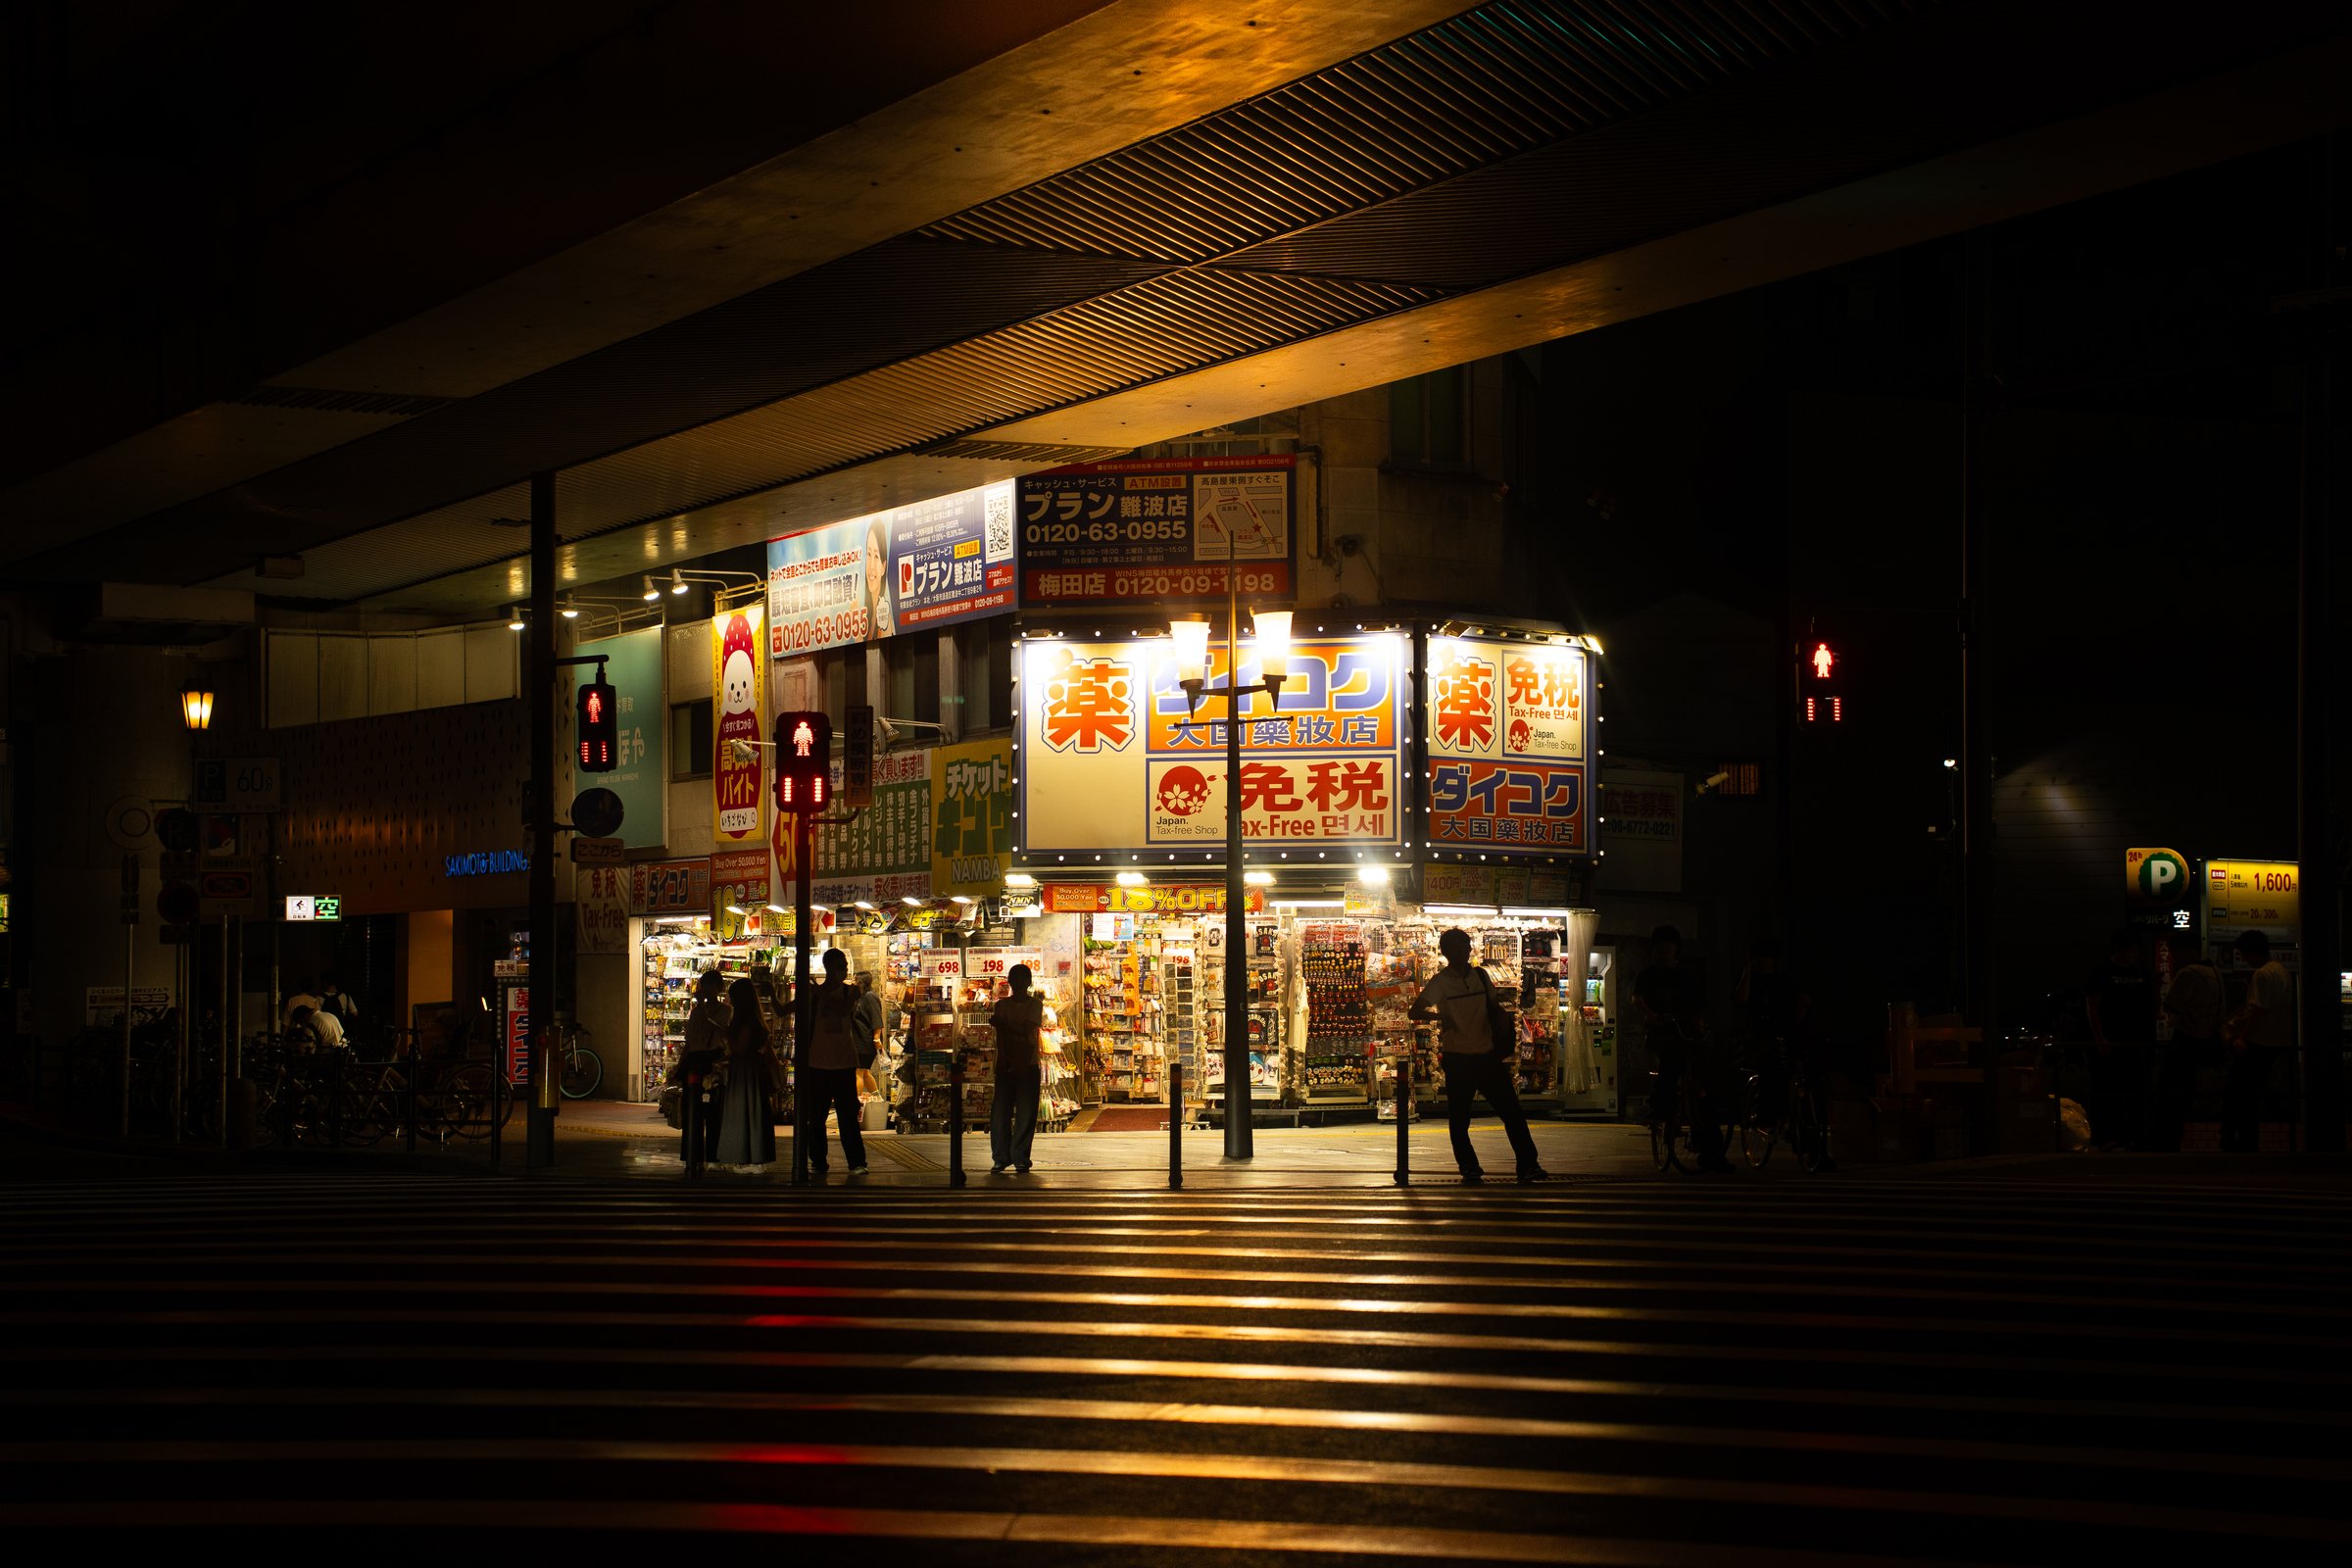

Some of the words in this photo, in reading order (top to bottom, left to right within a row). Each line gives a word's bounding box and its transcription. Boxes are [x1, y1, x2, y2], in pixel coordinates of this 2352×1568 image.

[1024, 478, 1117, 489] キャッシュ・サービス
[1024, 491, 1114, 521] プラン
[1120, 494, 1188, 517] 難波店
[1026, 520, 1187, 544] 0120-63-0955
[915, 562, 953, 595] プラン
[954, 558, 982, 587] 難波店
[1039, 573, 1106, 597] 梅田店
[783, 608, 868, 652] 0120-63-0955
[1047, 662, 1132, 749] 薬
[1438, 661, 1494, 747] 薬
[1506, 656, 1581, 709] 免税
[1509, 705, 1551, 720] Tax-Free
[1534, 738, 1559, 751] Tax-free
[1560, 740, 1578, 752] Shop
[722, 772, 755, 806] バイト
[945, 758, 1008, 800] チケット
[1224, 760, 1390, 813] 免税
[1431, 763, 1582, 818] ダイコク
[1604, 789, 1677, 817] 広告募集
[909, 788, 918, 864] 金プラチナ
[1156, 825, 1193, 836] Tax-free
[1195, 825, 1218, 836] Shop
[1225, 814, 1315, 838] ax-Free
[1321, 813, 1385, 837] 면세
[445, 851, 488, 878] SAKIMOTO
[489, 848, 529, 874] BUILDING
[578, 843, 622, 858] ここから
[591, 866, 616, 900] 免税
[952, 856, 1002, 884] NAMBA
[2150, 859, 2178, 897] P
[649, 867, 690, 907] ダイコク
[1007, 896, 1031, 905] NMN
[315, 896, 339, 920] 空
[581, 902, 625, 930] Tax-Free
[2173, 909, 2190, 929] 空
[938, 961, 959, 973] 698
[982, 959, 1004, 973] 198
[1171, 955, 1190, 964] 198
[1258, 972, 1279, 984] OSAK
